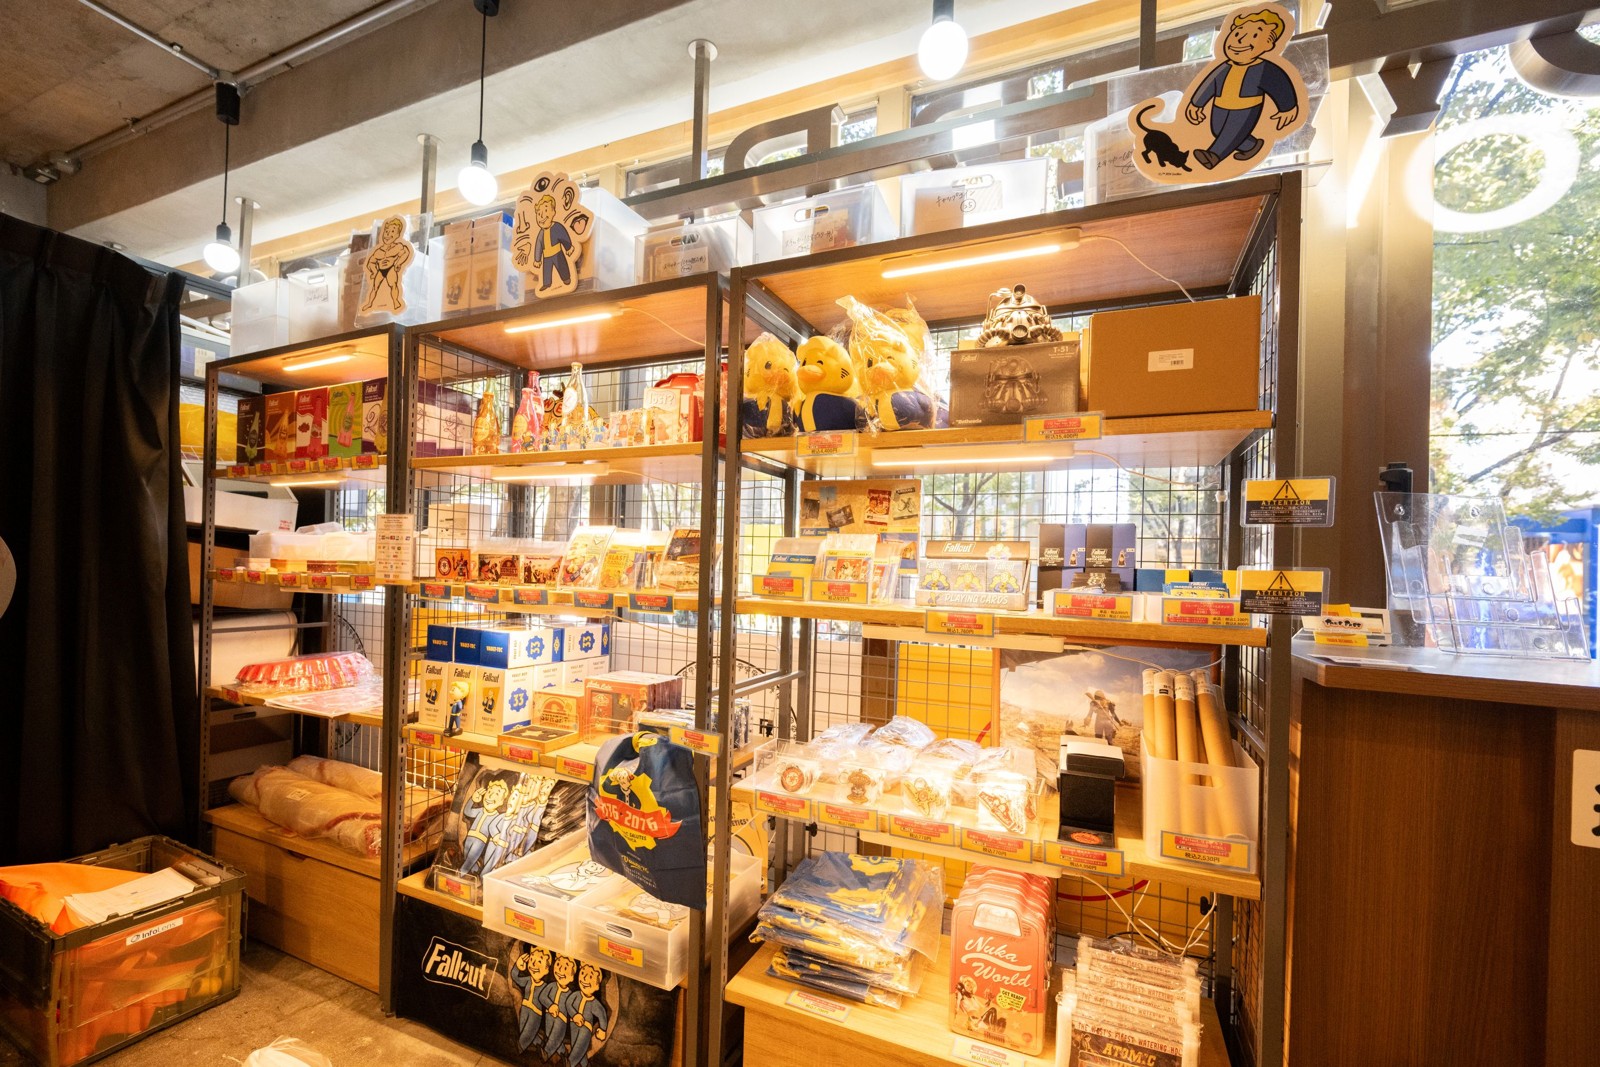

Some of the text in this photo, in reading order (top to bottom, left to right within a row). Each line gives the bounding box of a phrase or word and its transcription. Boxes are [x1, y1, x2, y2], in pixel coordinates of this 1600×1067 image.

[944, 543, 972, 552] Fallout
[926, 561, 944, 569] Fallout
[958, 562, 978, 571] Fallout
[944, 594, 1008, 604] PLAYING CARDS
[426, 665, 442, 675] Fallout
[454, 668, 471, 678] Fallout
[483, 672, 499, 683] Fallout
[513, 694, 524, 707] 33
[624, 811, 658, 832] 2076
[982, 847, 1006, 856] 税込770円
[1185, 852, 1220, 863] 税込2,530円
[142, 923, 176, 938] InfoLens
[964, 937, 1018, 962] Nuka
[426, 944, 486, 991] Fallout
[972, 962, 1031, 987] World
[1011, 992, 1024, 1001] READY
[1079, 1022, 1088, 1030] THE
[1138, 1039, 1168, 1052] WATERING
[1103, 1042, 1156, 1066] ATOMIC
